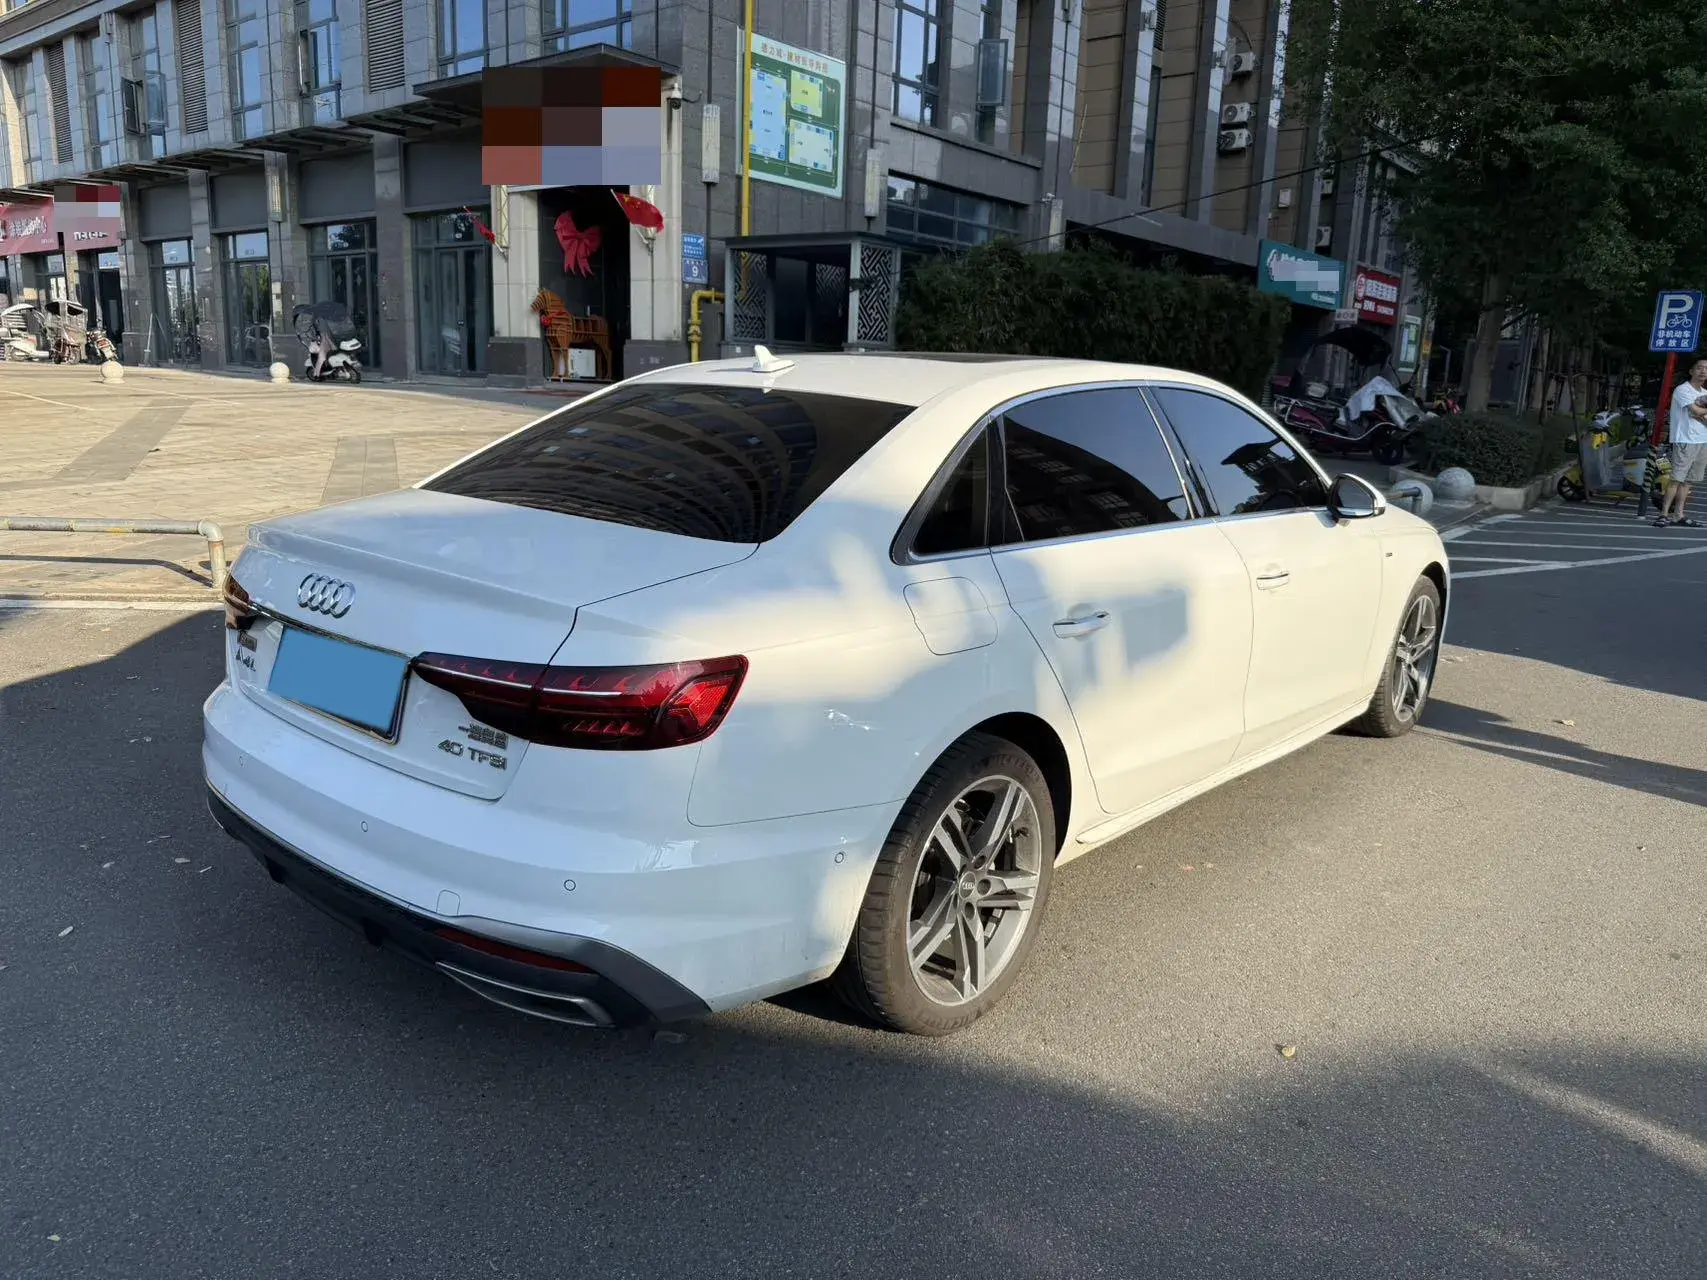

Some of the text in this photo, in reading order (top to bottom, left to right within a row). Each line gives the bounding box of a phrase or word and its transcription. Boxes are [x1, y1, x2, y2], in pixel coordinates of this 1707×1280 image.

[692, 265, 699, 277] 9
[1658, 294, 1694, 329] P
[1657, 330, 1691, 339] 非机动车
[1655, 339, 1690, 348] 停放区
[438, 739, 508, 771] 40 TFSI
